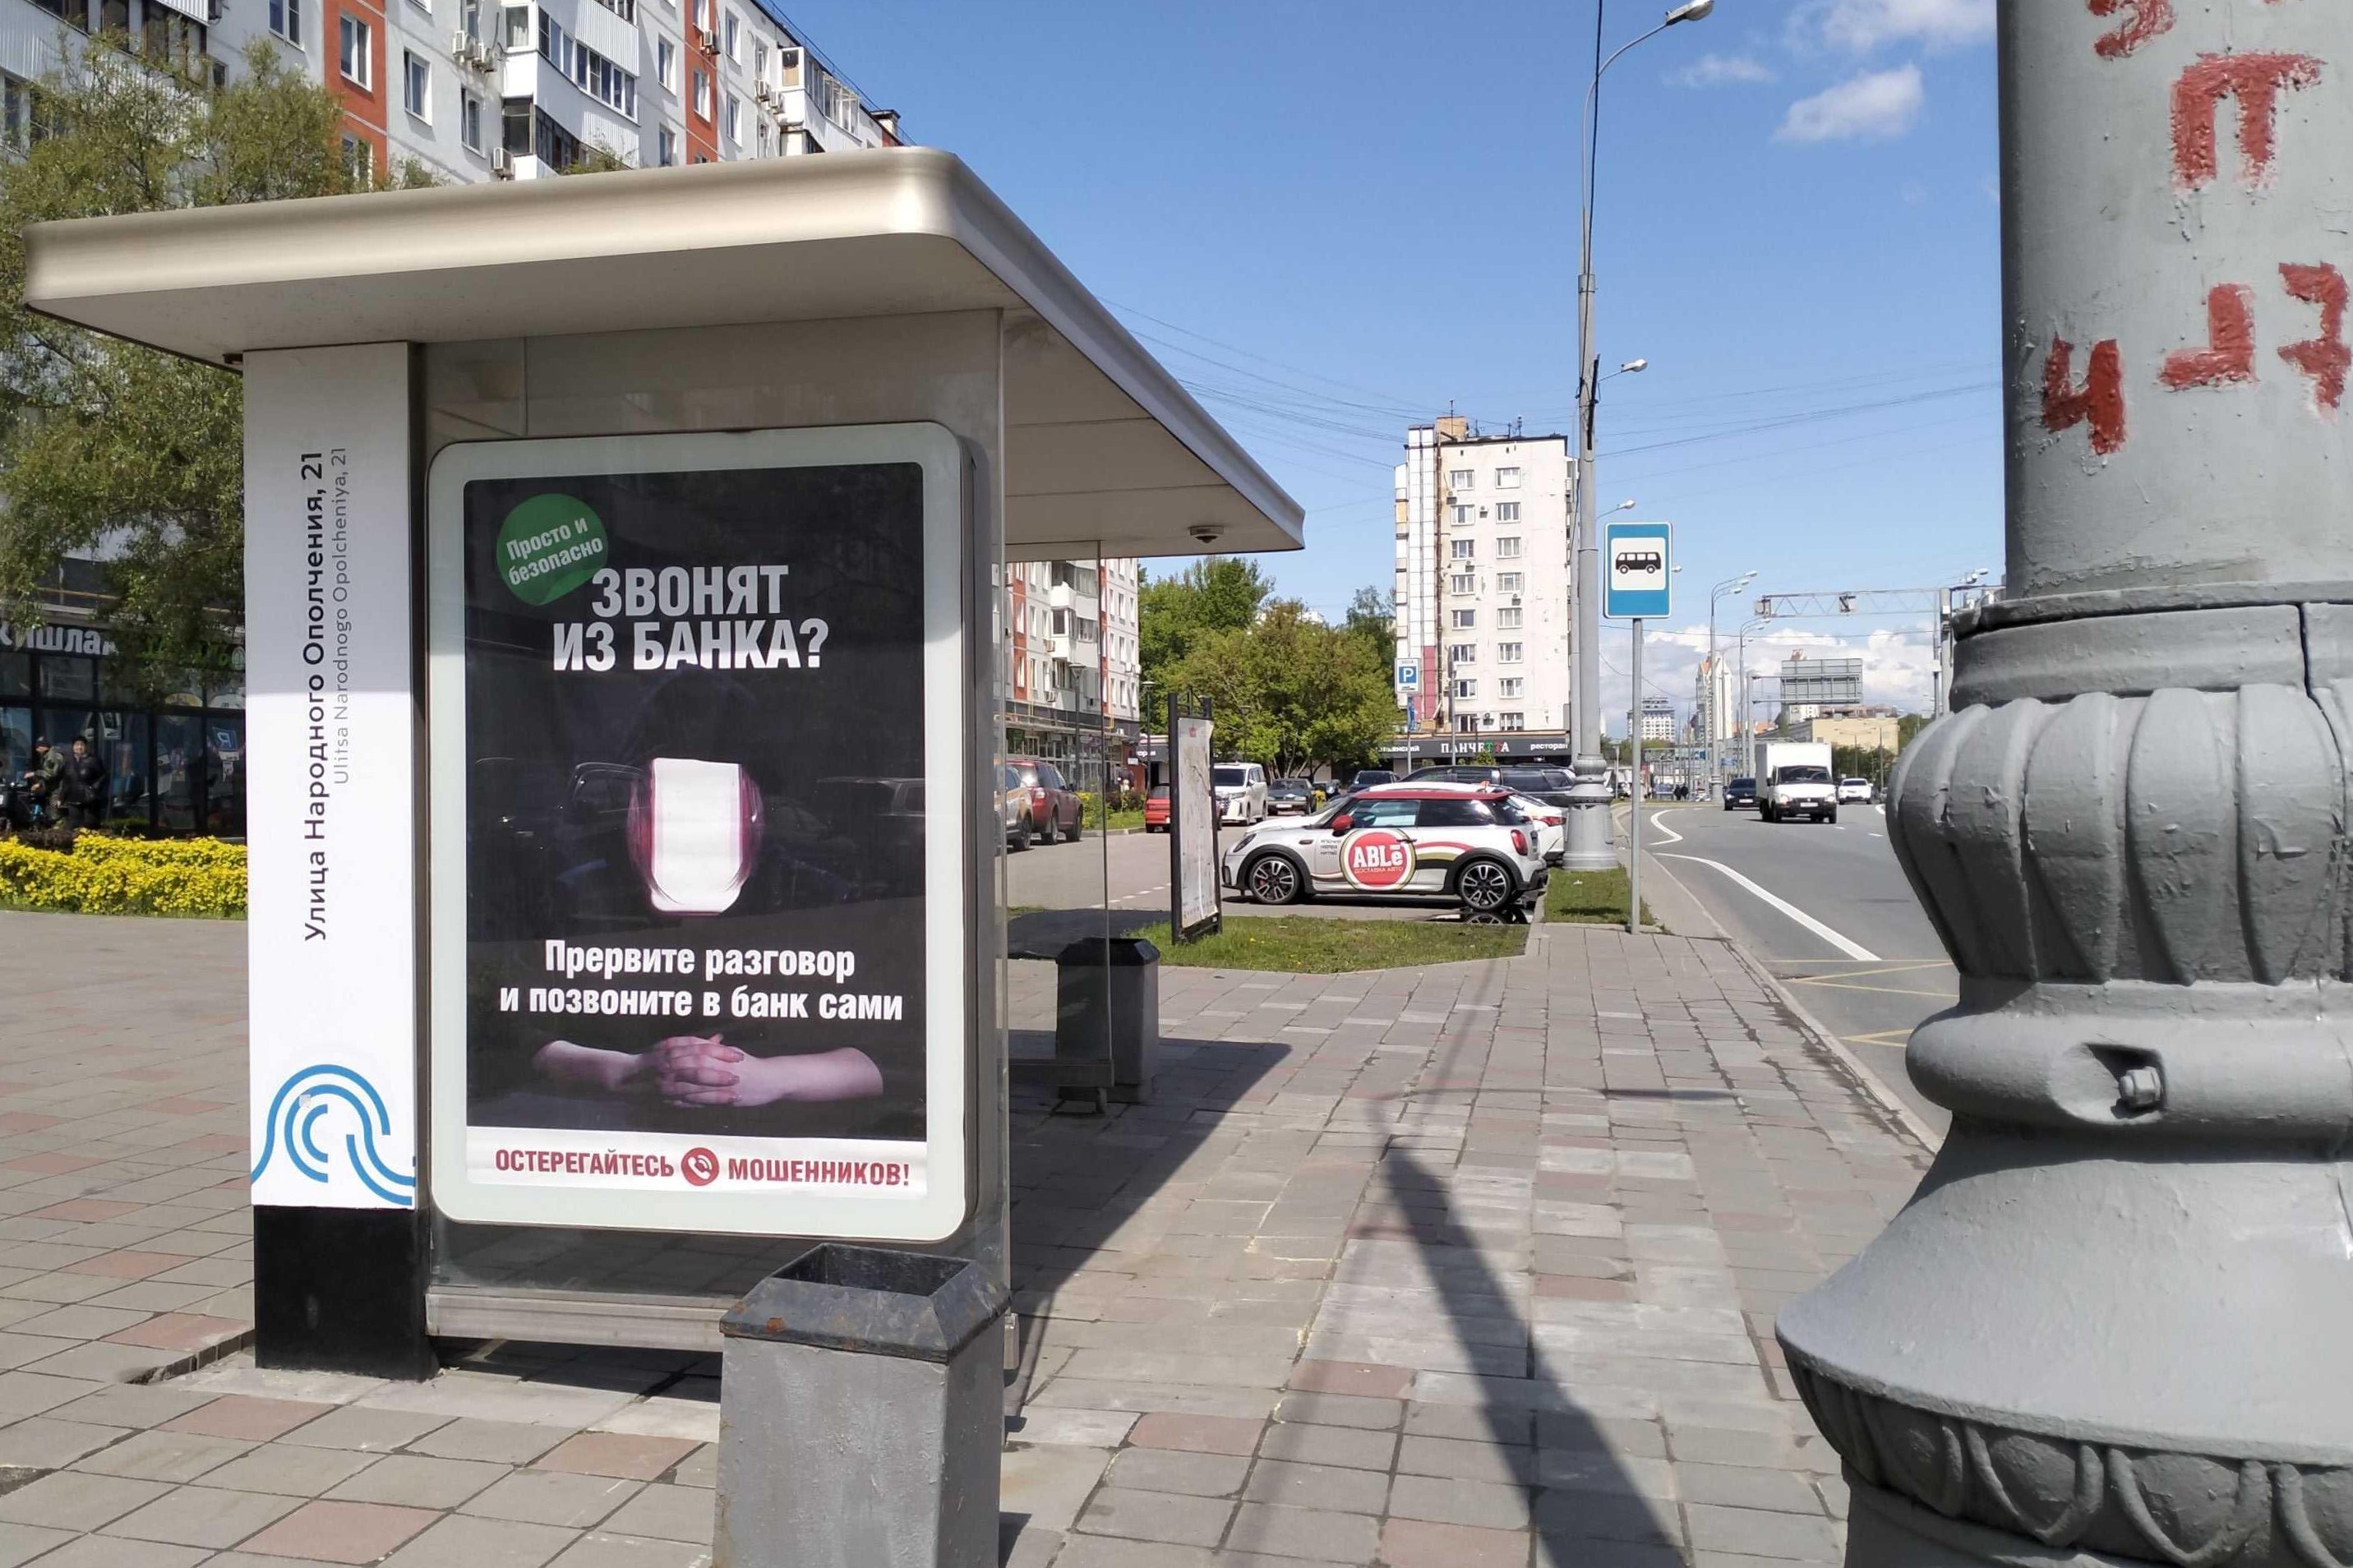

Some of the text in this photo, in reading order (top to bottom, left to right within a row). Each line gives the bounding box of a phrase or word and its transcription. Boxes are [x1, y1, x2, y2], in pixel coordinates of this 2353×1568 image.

[506, 516, 589, 560] Просто и
[508, 537, 603, 587] безопасно
[331, 447, 352, 785] Ulitsa Narodnogo Opolcheniya, 21
[592, 565, 789, 618] ЗВОНЯТ
[552, 617, 829, 671] ИЗ БАНКА?
[301, 452, 330, 941] Улица Народного Ополчения, 21
[545, 939, 856, 983] Прервите разговор
[500, 985, 902, 1021] и позвоните в банк сами
[495, 1147, 911, 1187] ОСТЕРЕГАЙТЕСЬ МОШЕННИКОВ!
